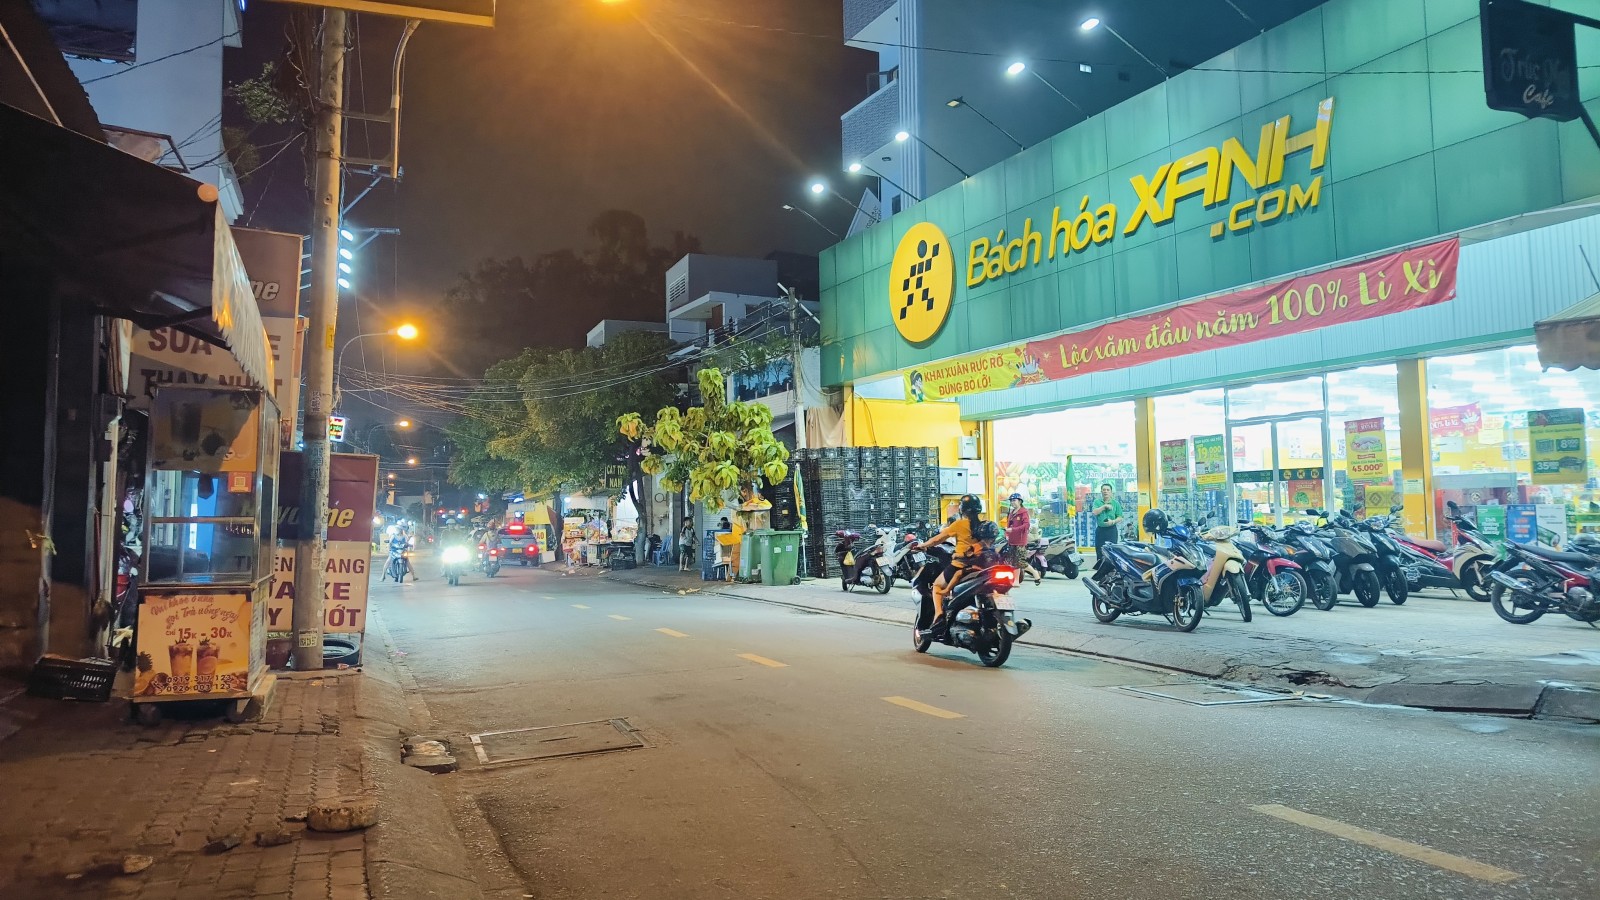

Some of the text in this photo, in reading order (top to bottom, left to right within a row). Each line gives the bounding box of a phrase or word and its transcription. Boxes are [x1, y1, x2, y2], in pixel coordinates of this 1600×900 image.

[967, 96, 1334, 287] Bách hóa XANH
[1210, 175, 1323, 238] .COM
[1059, 343, 1094, 371] Lộc
[1145, 316, 1193, 350] đầu
[1196, 309, 1259, 340] năm
[1265, 278, 1349, 325] 100%
[1358, 271, 1393, 306] Lì
[1402, 259, 1443, 296] Xì
[924, 369, 945, 382] KHAI
[945, 362, 969, 378] XUÂN
[326, 558, 365, 574] ANG
[323, 604, 361, 627] ỚT
